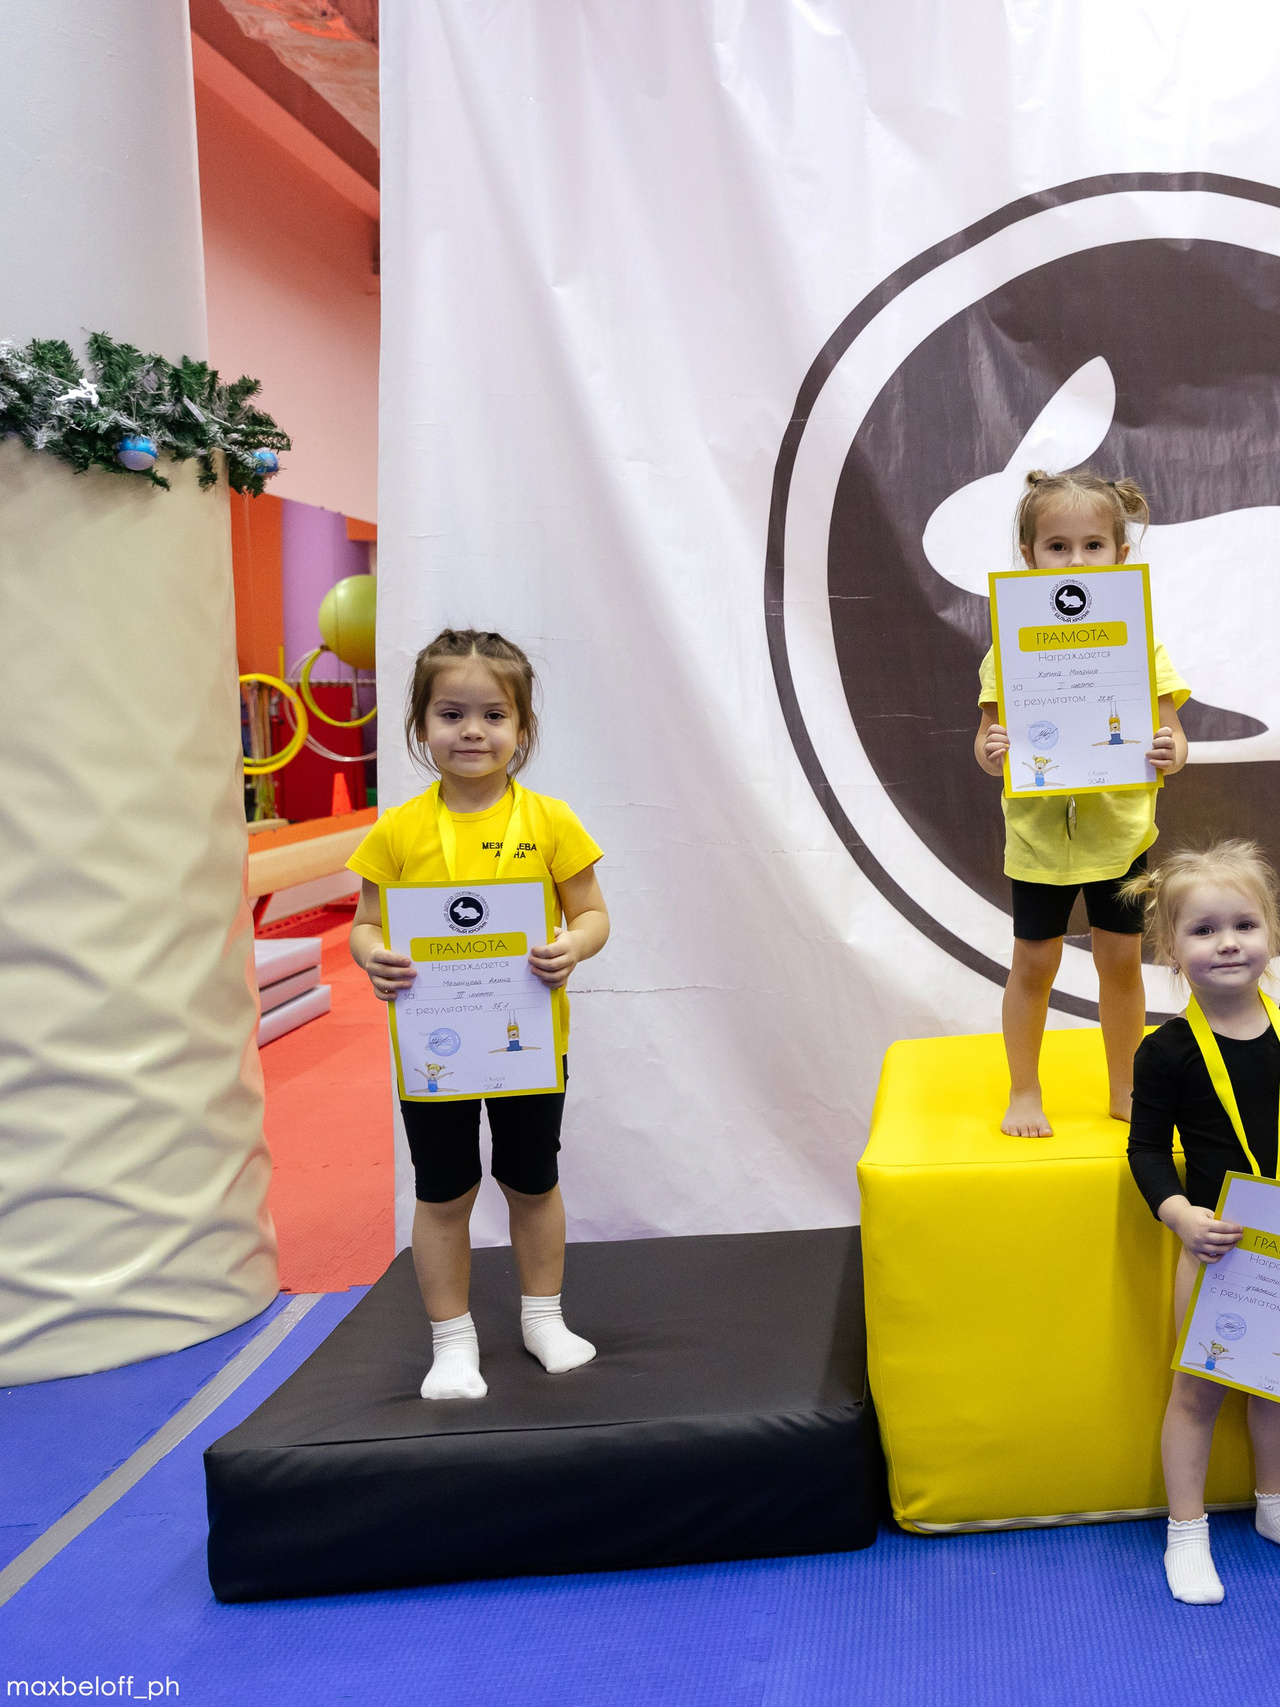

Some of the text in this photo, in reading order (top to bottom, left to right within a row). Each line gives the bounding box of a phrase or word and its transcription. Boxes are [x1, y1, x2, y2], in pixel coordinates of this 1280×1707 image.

[1036, 628, 1110, 645] ГРАМОТА
[1038, 650, 1111, 662] Награждается
[1012, 684, 1023, 692] за
[1024, 695, 1086, 708] результатом
[429, 939, 508, 955] ГРАМОТА
[431, 961, 509, 973] Награждается
[416, 1004, 482, 1016] результатом
[1213, 1273, 1225, 1281] за
